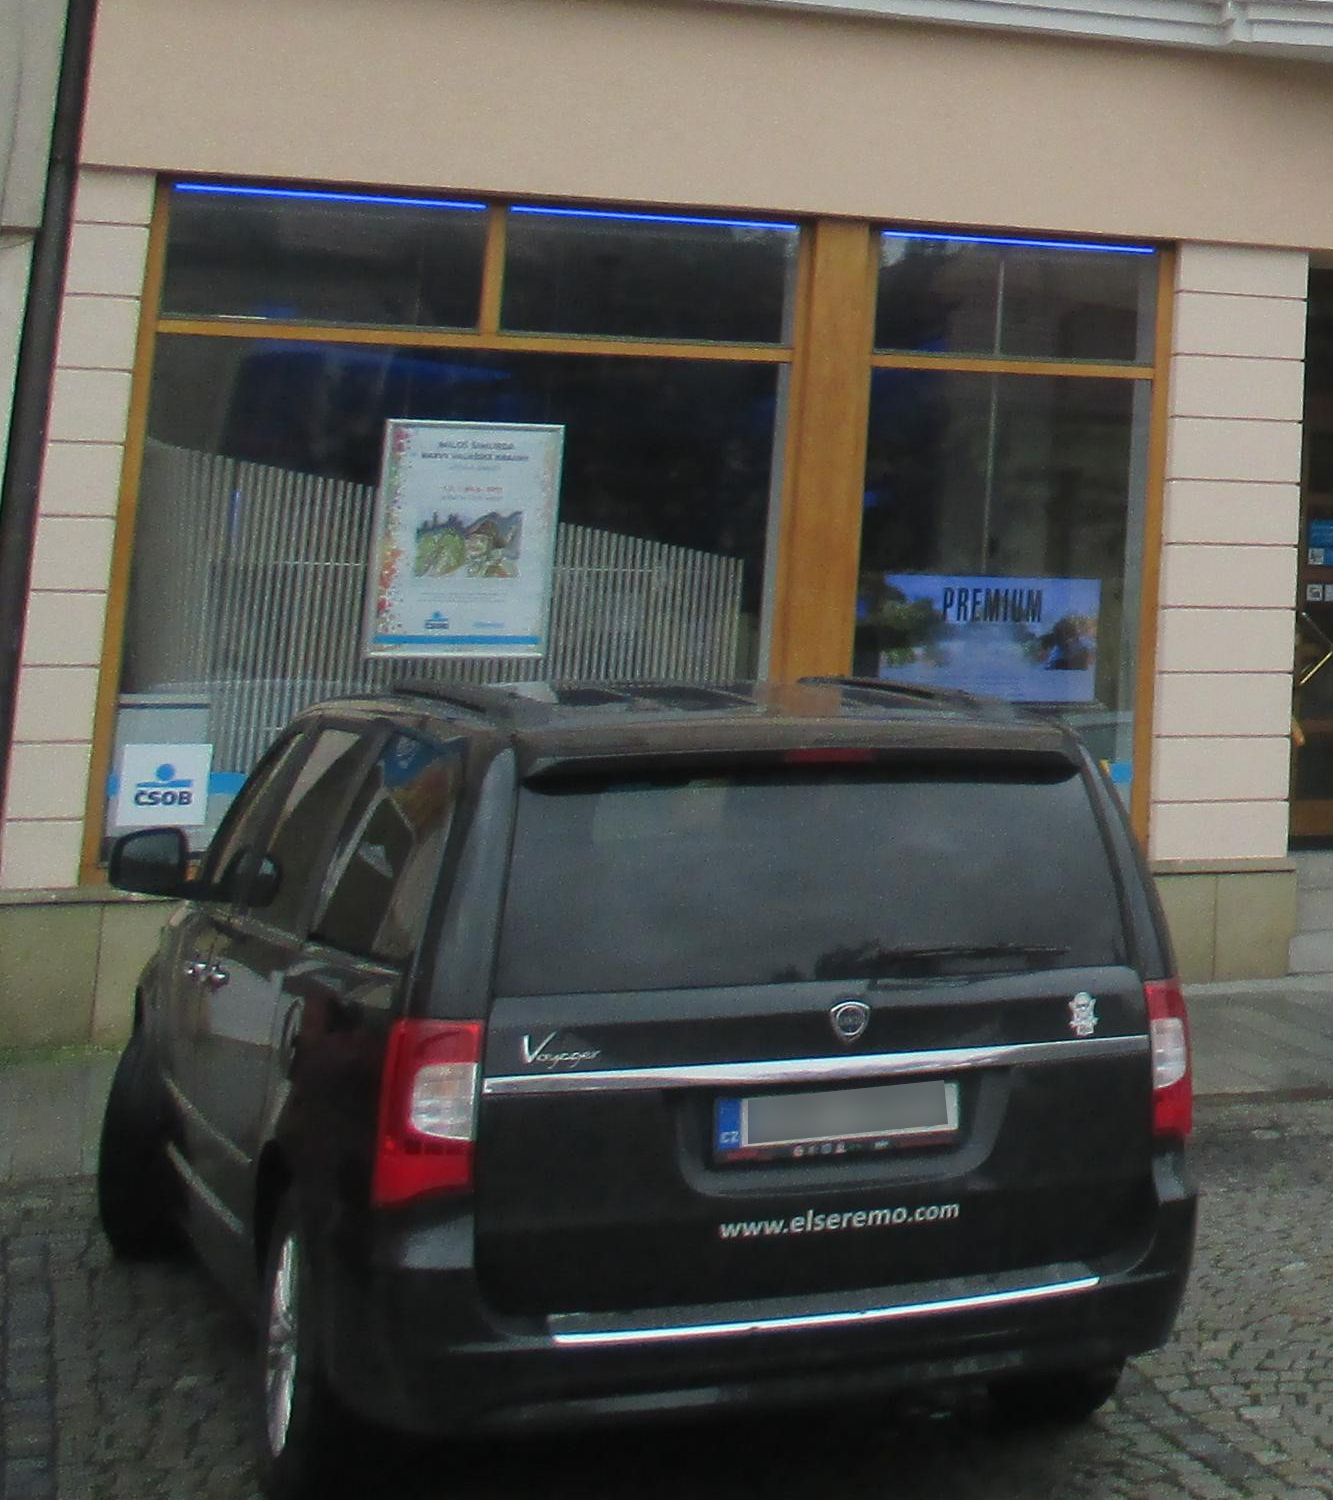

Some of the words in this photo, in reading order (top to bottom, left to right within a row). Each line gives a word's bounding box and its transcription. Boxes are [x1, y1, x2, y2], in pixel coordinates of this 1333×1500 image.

[942, 586, 1044, 623] PREMIUM
[134, 789, 193, 806] ČSOB
[523, 1031, 602, 1070] Voyager
[719, 1130, 740, 1144] CZ
[718, 1203, 961, 1239] www.elseremo.com
